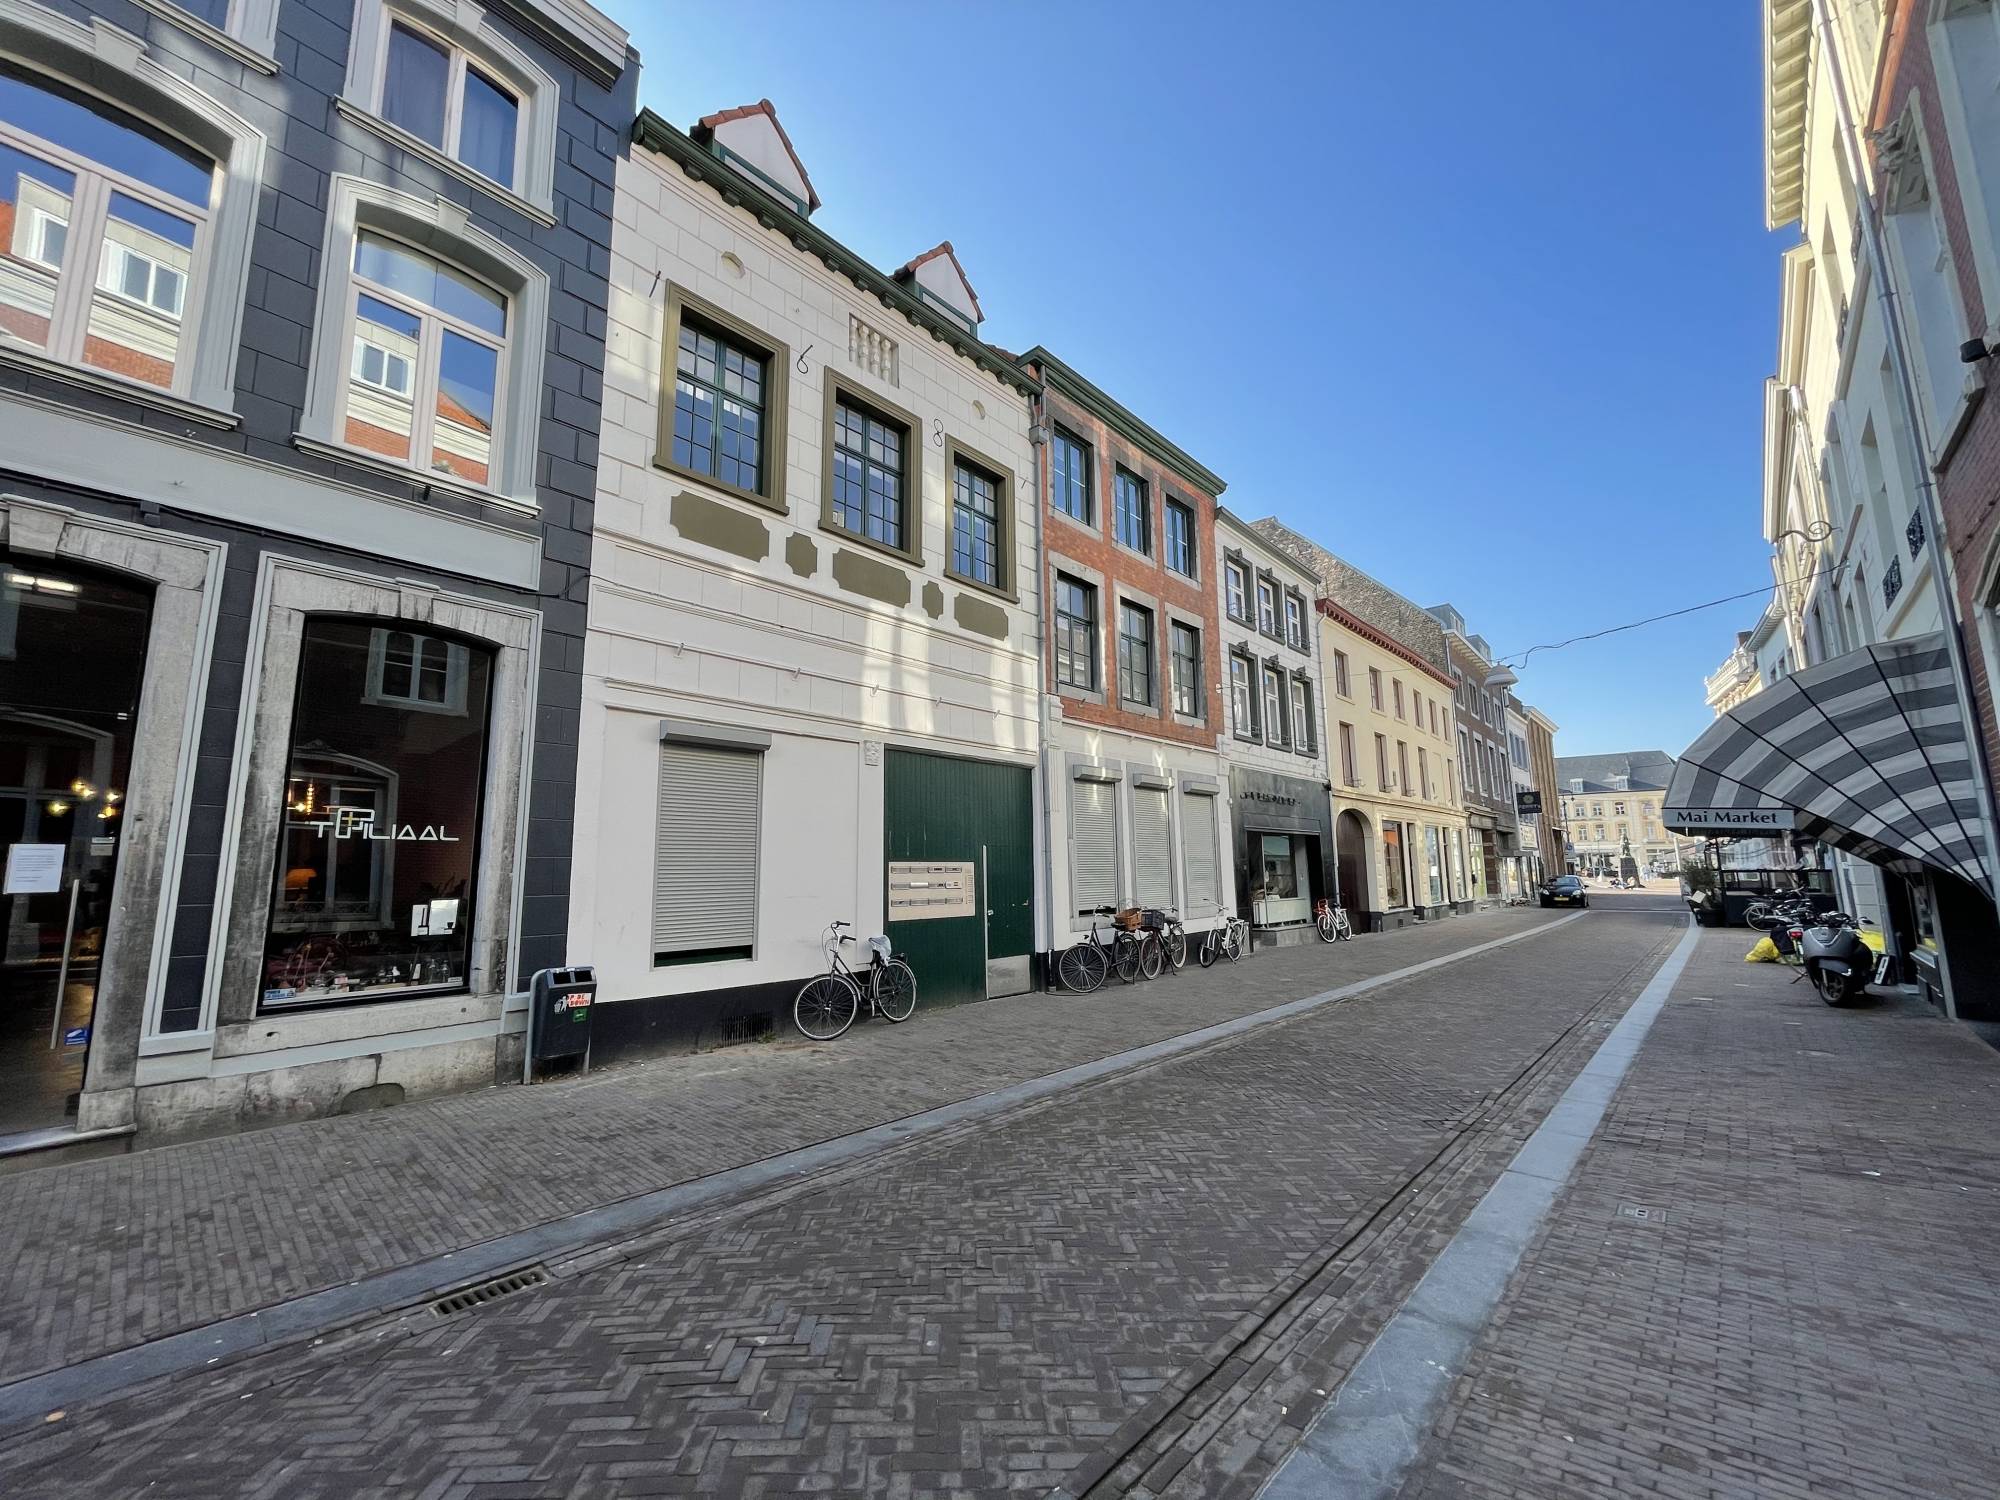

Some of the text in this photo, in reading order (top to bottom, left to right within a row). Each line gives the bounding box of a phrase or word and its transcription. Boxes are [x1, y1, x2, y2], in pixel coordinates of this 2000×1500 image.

[335, 807, 460, 841] FILIAAL
[1677, 810, 1777, 824] Mai Market
